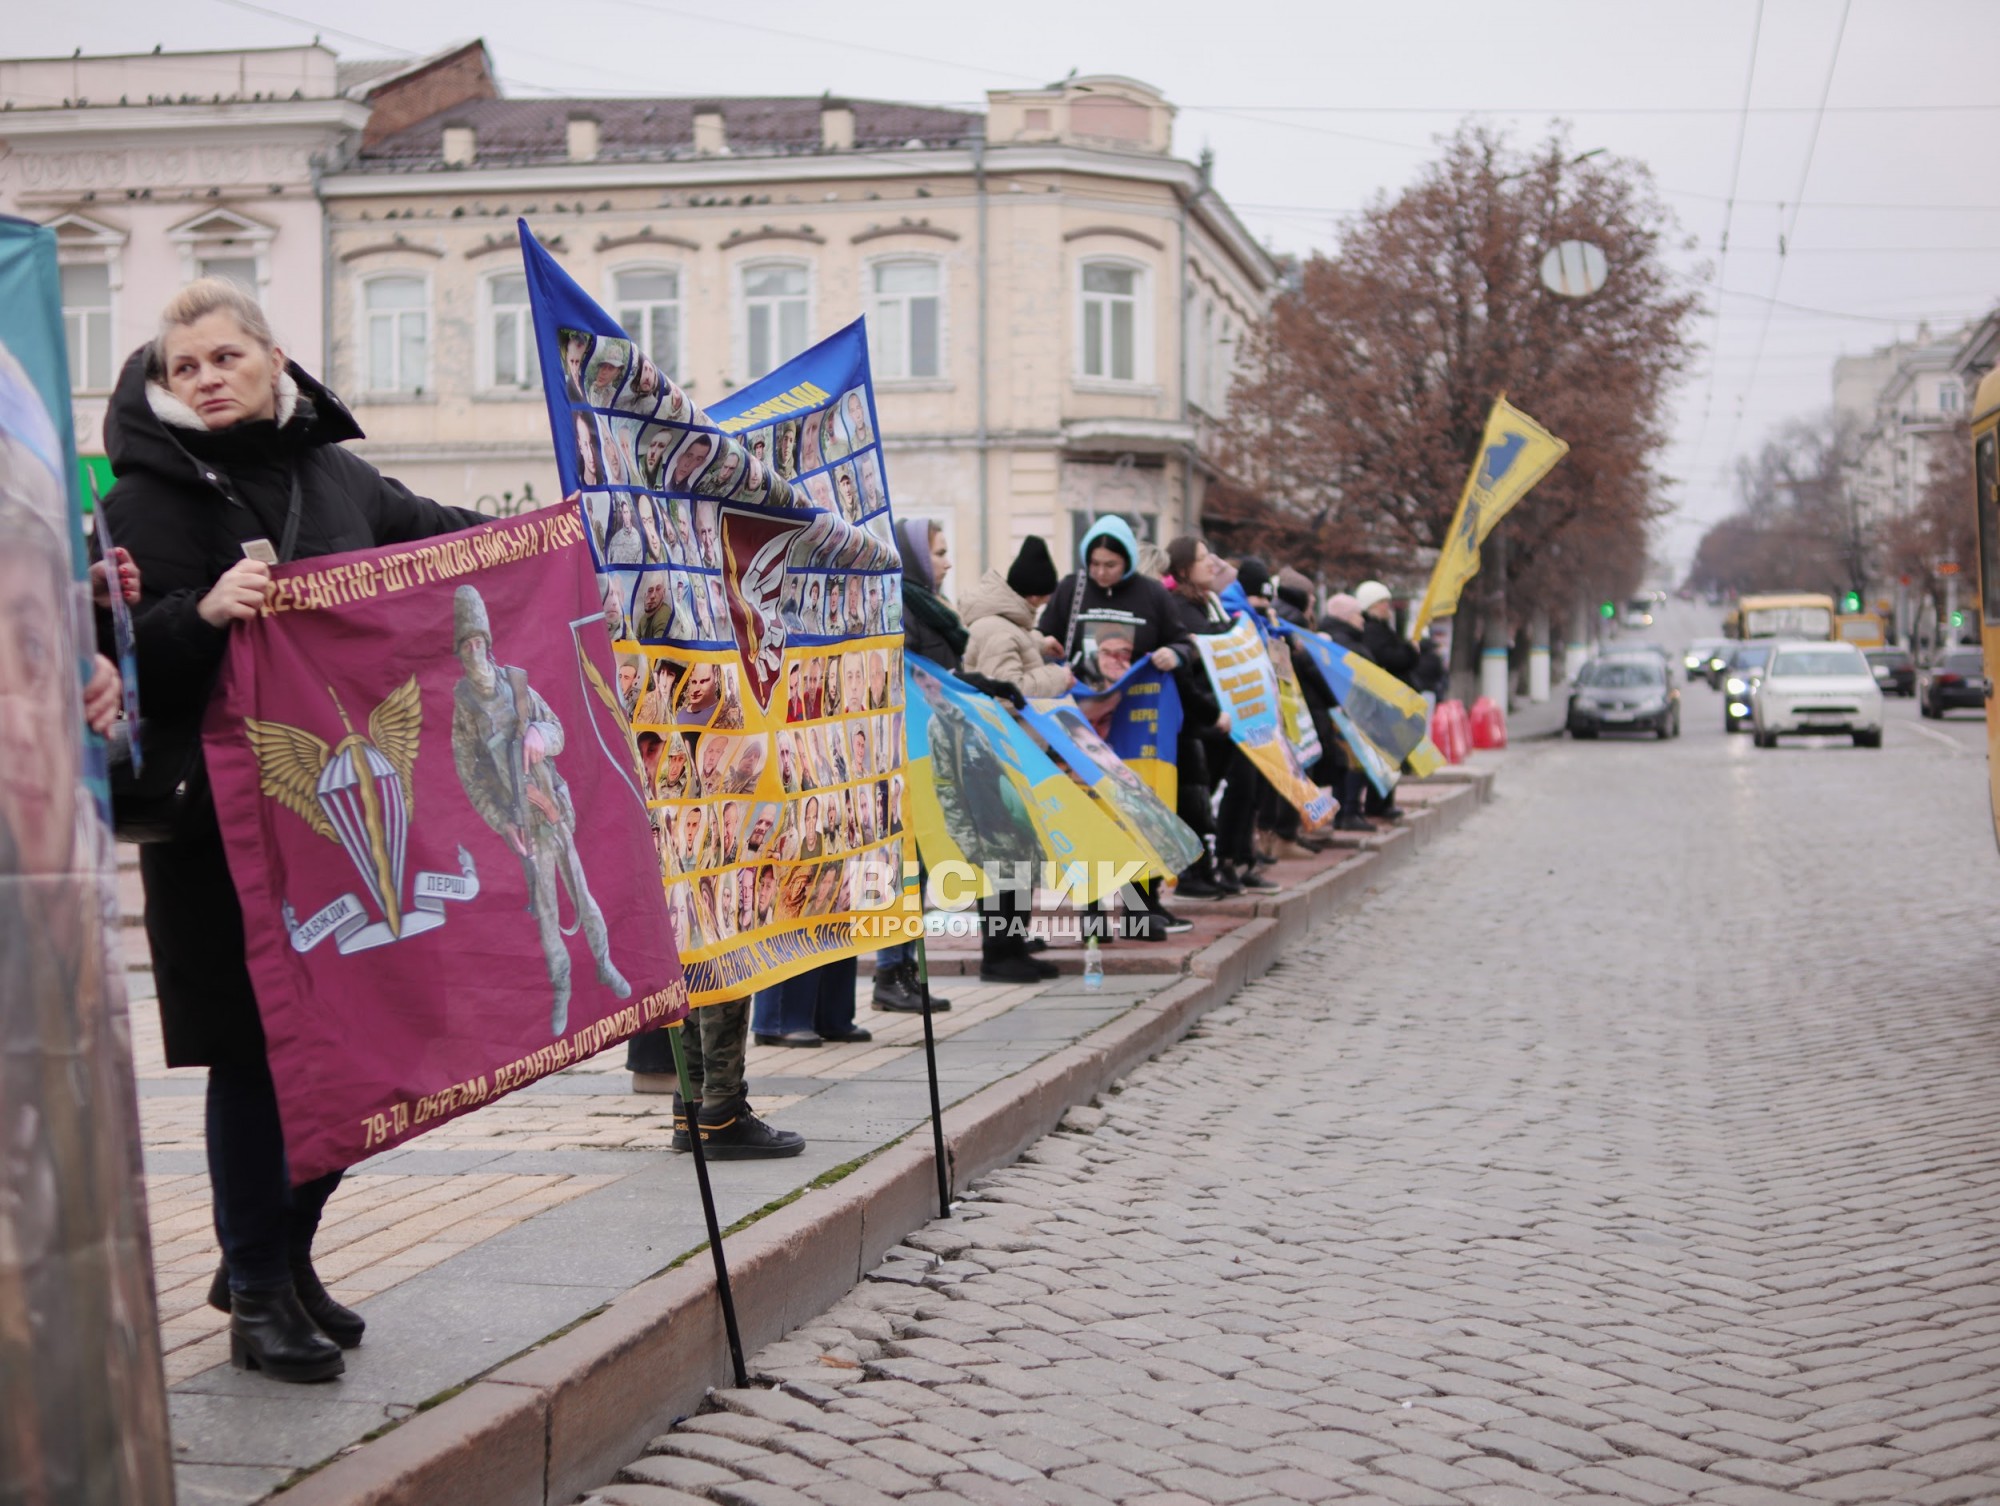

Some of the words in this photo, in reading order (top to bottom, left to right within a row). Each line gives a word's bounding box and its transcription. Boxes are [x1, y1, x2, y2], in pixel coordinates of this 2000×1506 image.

[740, 381, 831, 421] БРИГАДА
[260, 538, 478, 618] ДЕСАНТНО-ШТУРМОВІ
[473, 522, 539, 569] ВІЙСЬКА
[427, 875, 466, 895] ПЕРШІ
[298, 899, 351, 945] ЗАВЖДИ
[719, 944, 762, 987] БЕЗВІСТИ
[754, 941, 778, 969] НЕ
[765, 927, 816, 964] ЗНАЧИТЬ
[681, 957, 723, 994] НИКЛИ
[361, 1102, 410, 1149] 79-ТА
[413, 1075, 489, 1125] ОКРЕМА
[488, 1003, 641, 1099] ДЕСАНТНО-ШТУРМОВА
